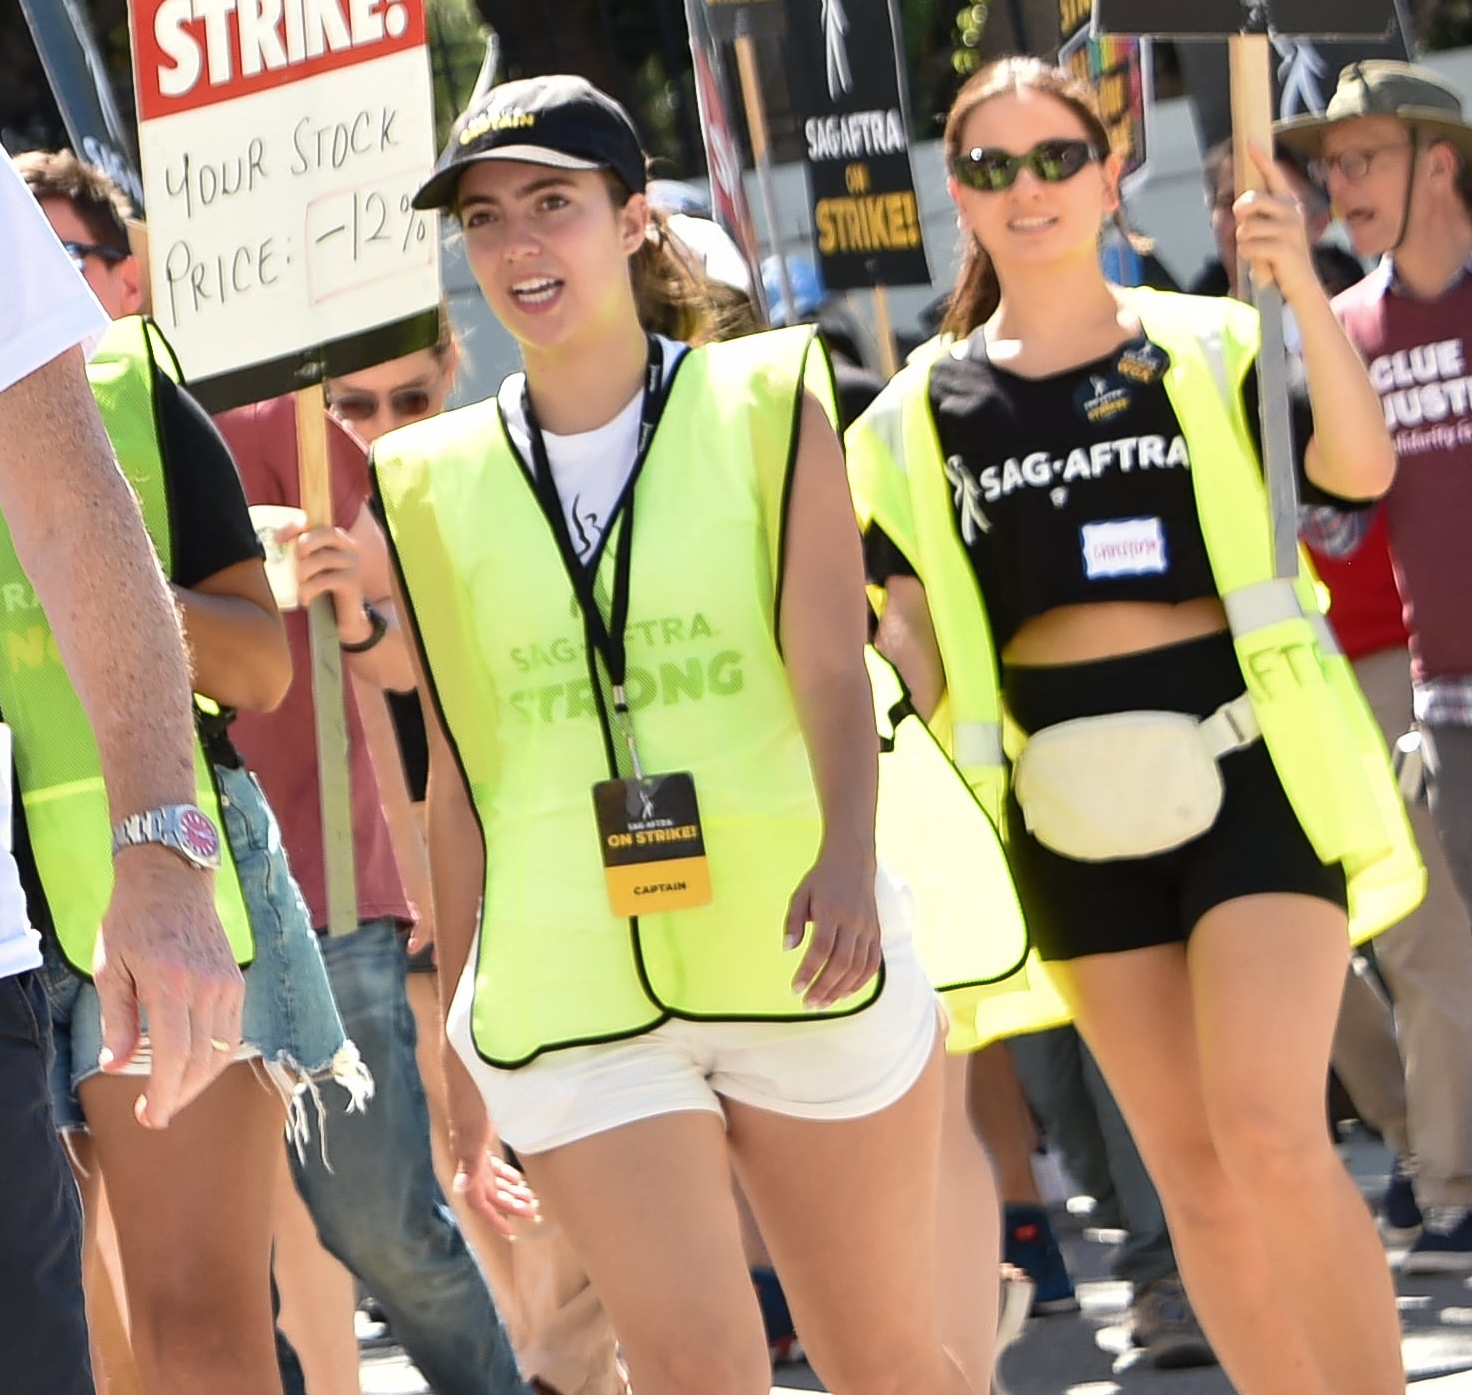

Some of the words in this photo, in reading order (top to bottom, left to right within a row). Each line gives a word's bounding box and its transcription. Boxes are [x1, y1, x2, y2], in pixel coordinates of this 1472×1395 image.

[165, 137, 265, 219] YOUR
[290, 106, 401, 177] STOCK
[845, 163, 870, 194] ON
[816, 192, 919, 255] STRIKE!
[165, 236, 294, 328] PRICE:
[509, 650, 744, 725] STRONG
[607, 834, 632, 847] ON
[636, 825, 697, 844] STRIKE!
[633, 882, 687, 895] CAPTAIN
